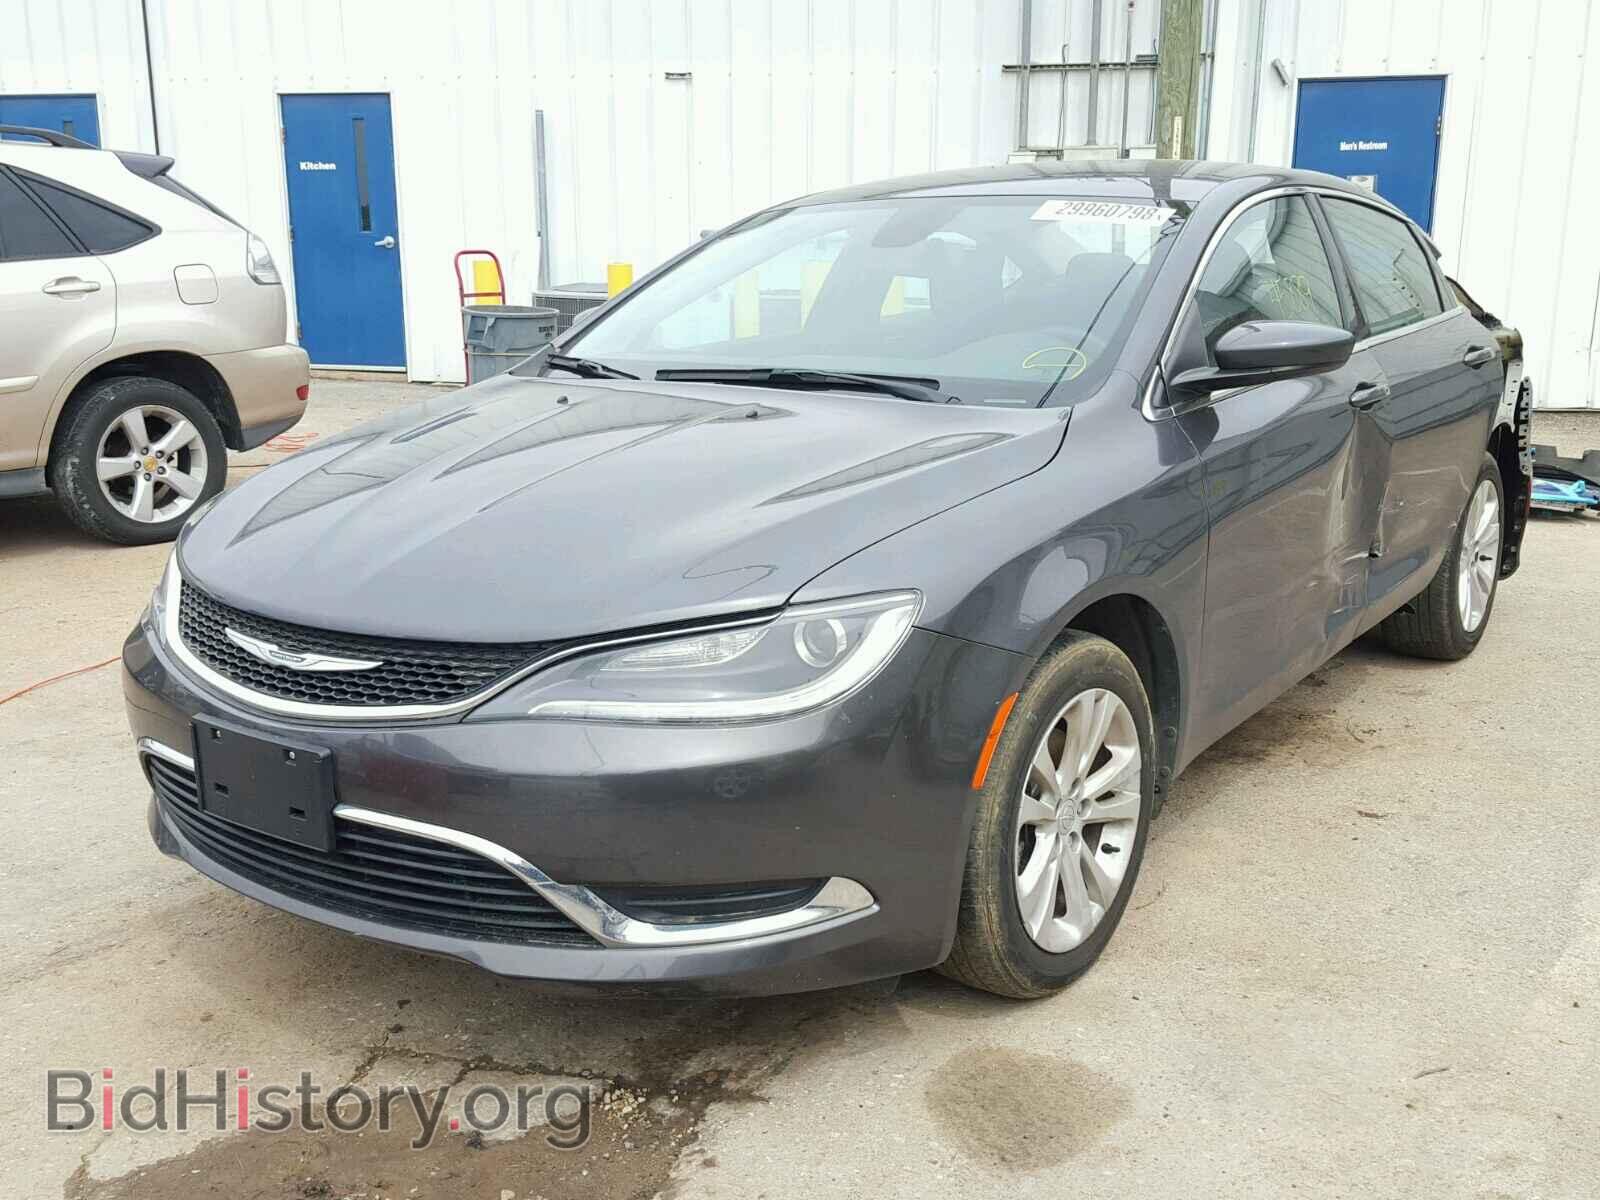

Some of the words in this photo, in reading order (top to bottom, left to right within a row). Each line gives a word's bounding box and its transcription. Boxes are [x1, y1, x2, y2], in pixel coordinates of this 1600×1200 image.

[1339, 141, 1357, 151] Men's
[1358, 140, 1388, 151] Restroom
[299, 161, 336, 171] Kitchen
[1055, 201, 1158, 220] 29960798
